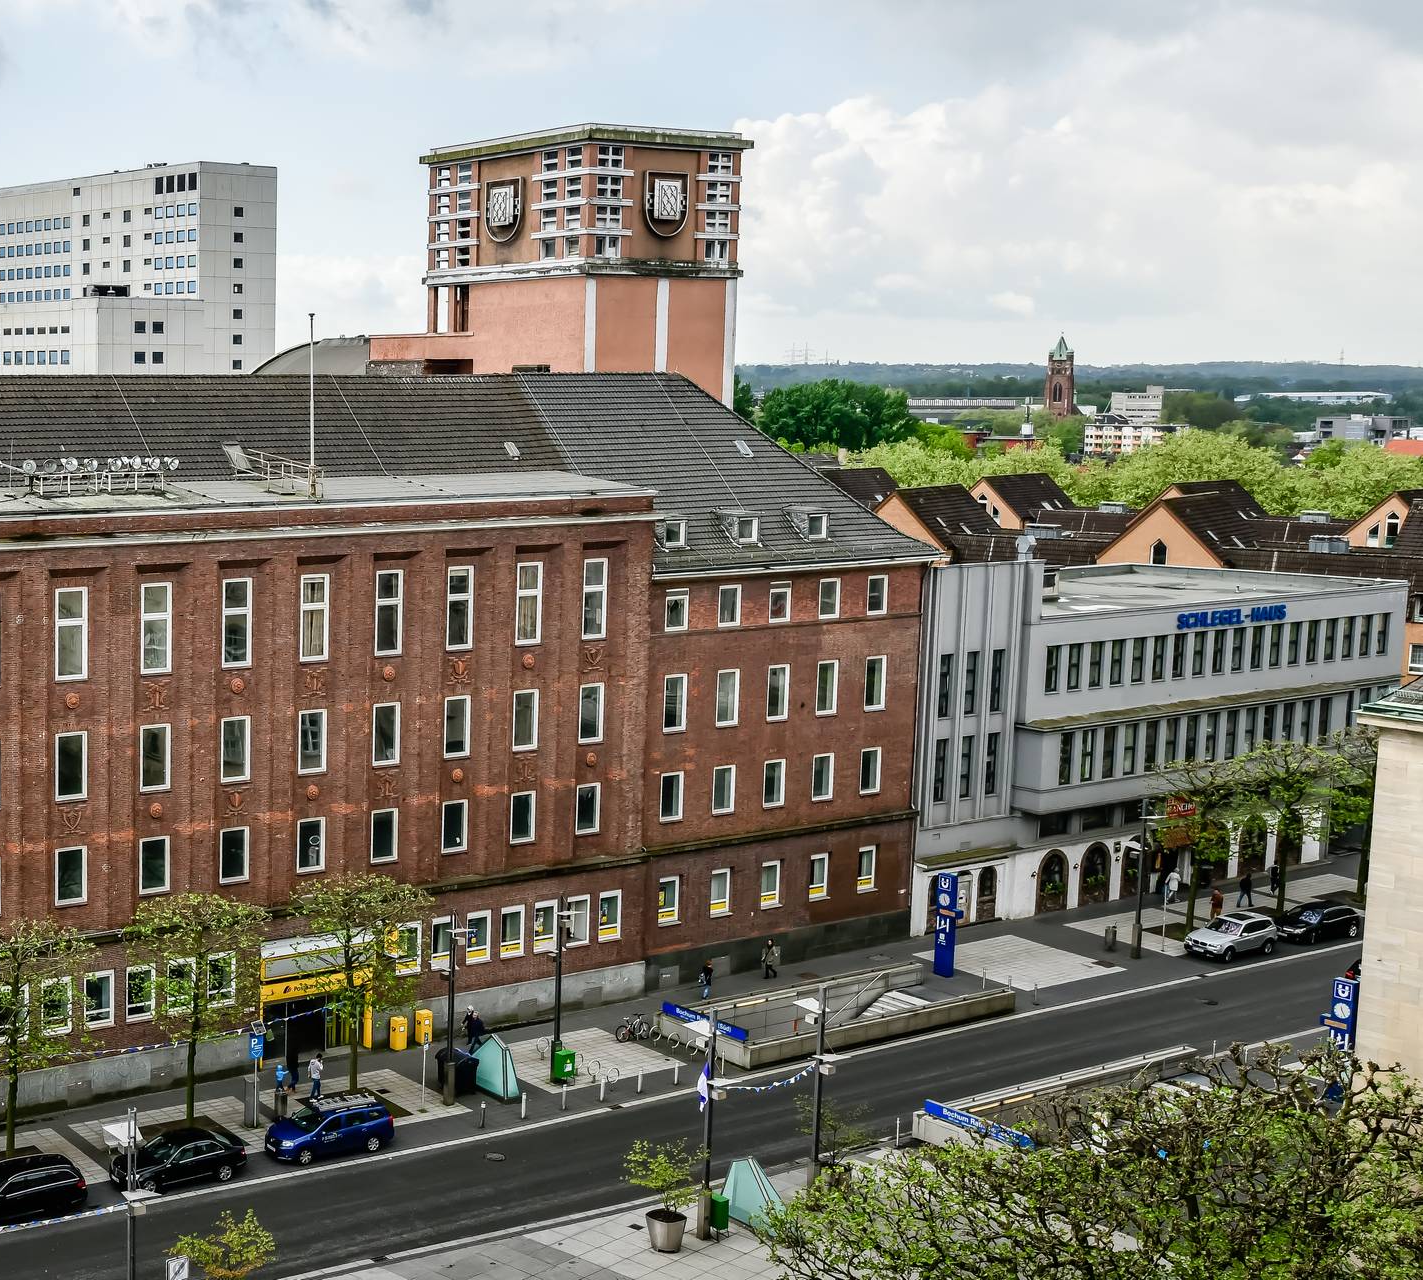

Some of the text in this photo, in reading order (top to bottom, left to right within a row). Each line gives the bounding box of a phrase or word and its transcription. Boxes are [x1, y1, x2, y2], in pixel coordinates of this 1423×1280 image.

[676, 1007, 696, 1020] Bochum
[717, 1022, 732, 1033] (Süd)
[251, 1038, 258, 1048] P
[942, 1107, 969, 1123] Bochum
